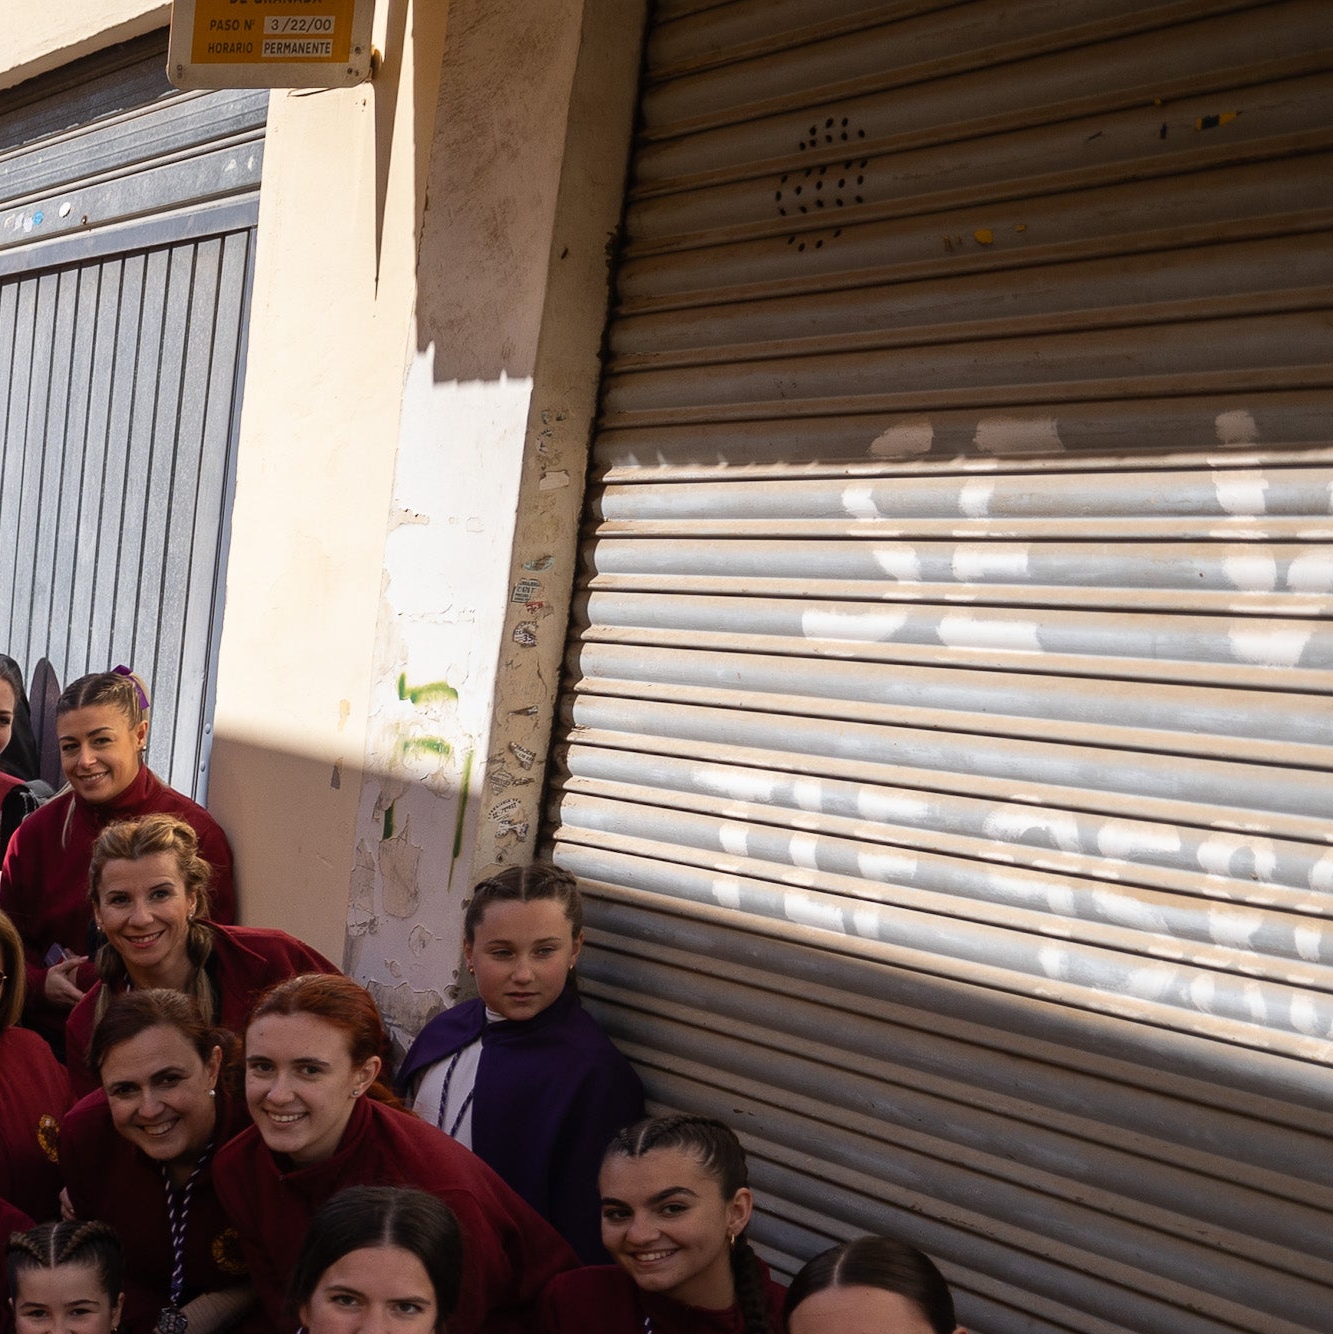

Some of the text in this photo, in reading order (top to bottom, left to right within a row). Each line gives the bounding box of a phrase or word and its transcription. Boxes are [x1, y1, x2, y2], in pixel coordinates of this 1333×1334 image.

[209, 19, 240, 31] PASO
[207, 41, 331, 54] HORARIO PERMANENTE
